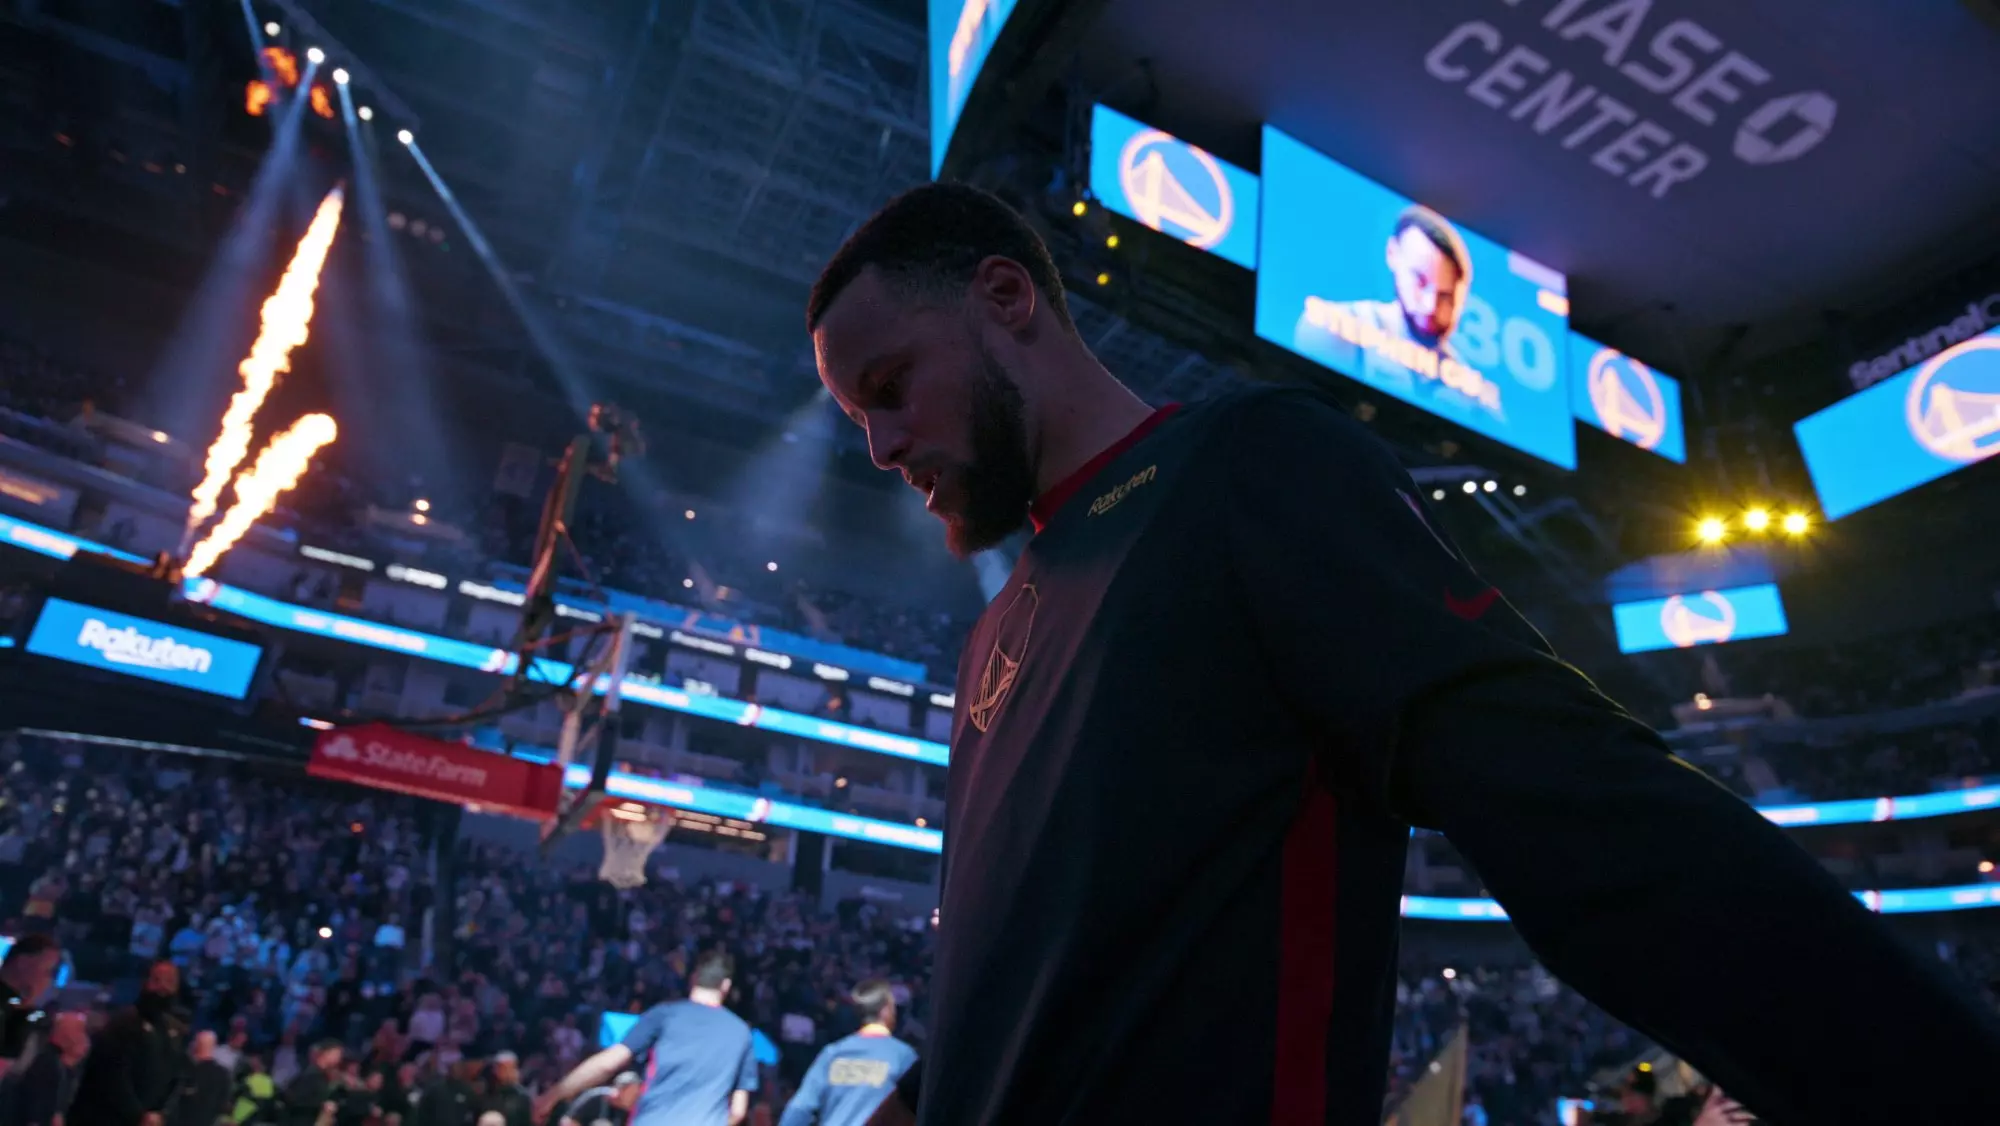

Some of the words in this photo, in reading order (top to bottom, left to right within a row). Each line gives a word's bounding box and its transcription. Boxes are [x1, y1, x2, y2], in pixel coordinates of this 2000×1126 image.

[1423, 21, 1709, 199] CENTER
[1448, 292, 1556, 392] 30
[1087, 464, 1157, 518] Rakuten
[77, 617, 213, 673] Rakuten
